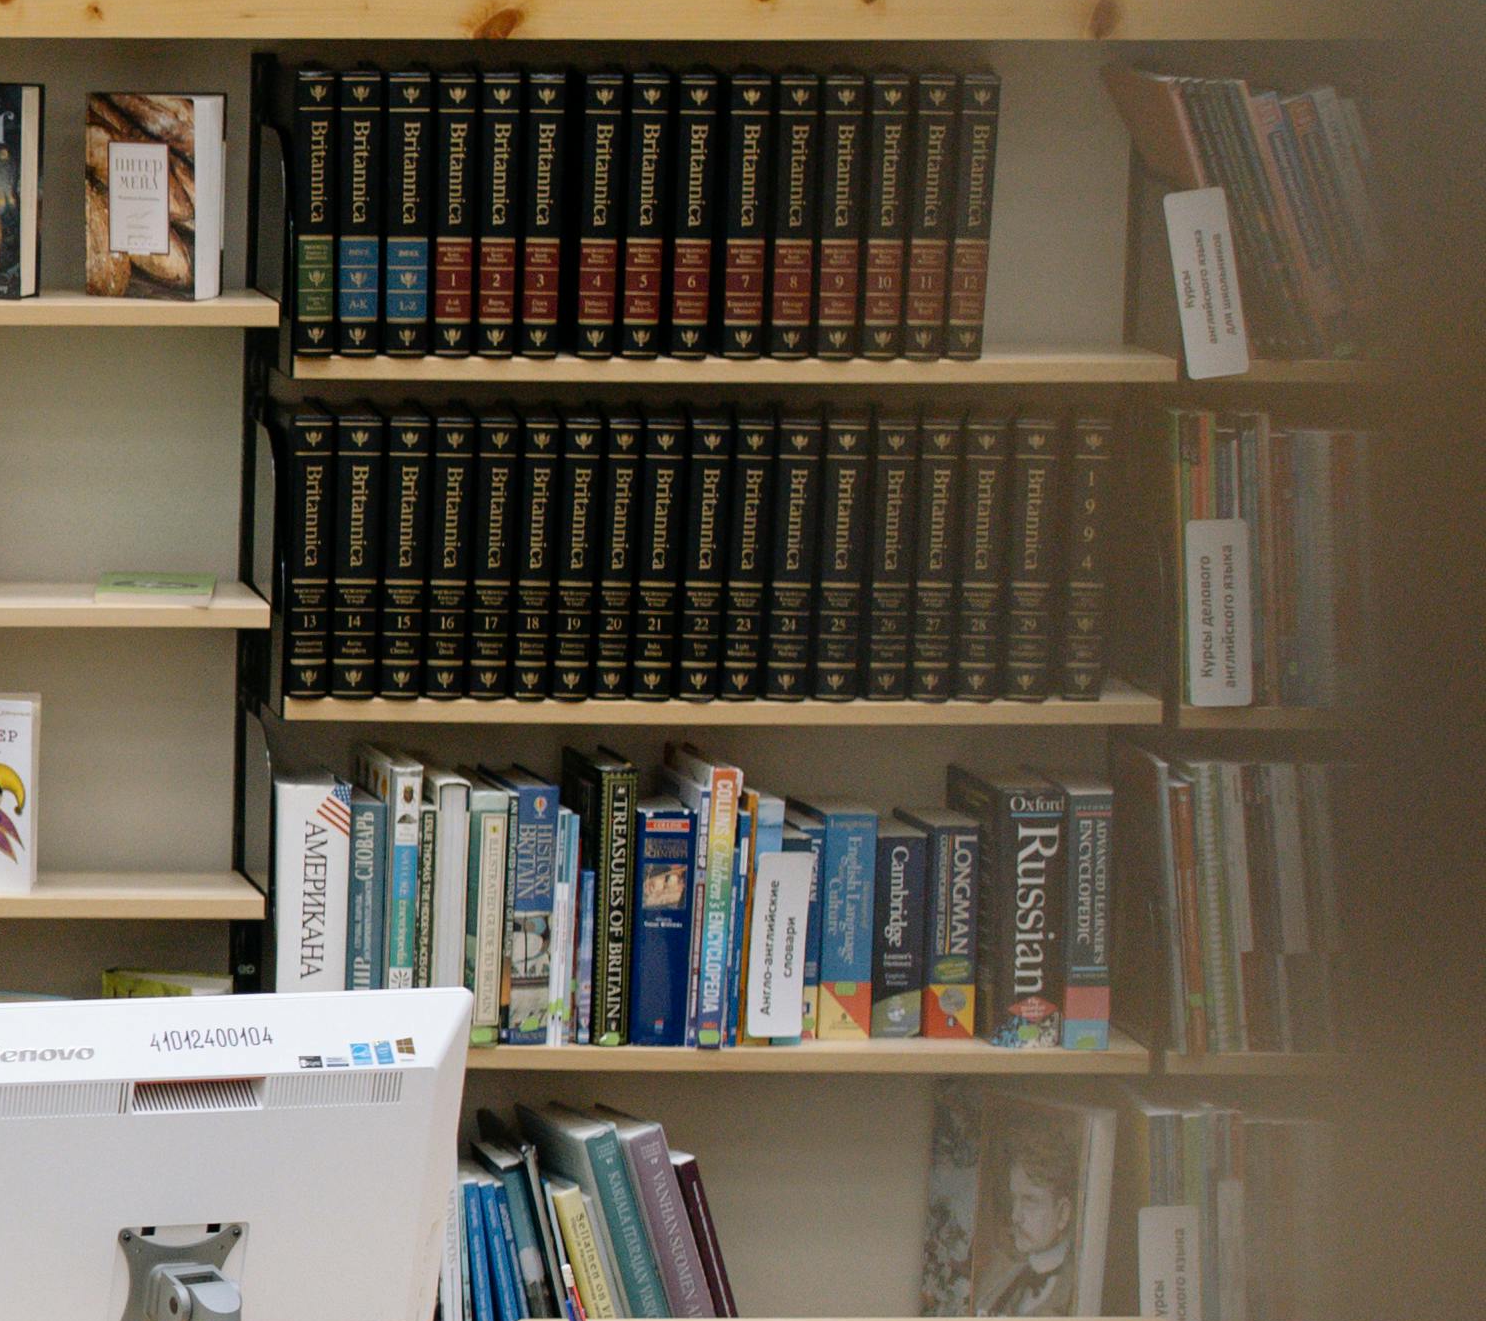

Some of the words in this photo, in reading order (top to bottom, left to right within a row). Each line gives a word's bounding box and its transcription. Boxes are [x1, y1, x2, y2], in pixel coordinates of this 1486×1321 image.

[115, 154, 164, 176] ПИТЕР
[311, 121, 328, 224] Britannica
[352, 121, 371, 224] Britannica
[404, 121, 421, 224] Britannica
[449, 122, 468, 226] Britannica
[493, 122, 511, 226] Britannica
[537, 122, 556, 226] Britannica
[593, 124, 614, 228] Britannica
[305, 465, 323, 567] Britannica
[350, 465, 369, 567] Britannica
[400, 466, 419, 568] Britannica
[488, 467, 508, 569] Britannica
[571, 468, 591, 570] Britannica
[1199, 556, 1213, 626] делового
[1222, 545, 1234, 590] языка
[1200, 631, 1215, 677] Курсы
[1222, 595, 1238, 687] английского
[355, 812, 374, 879] СЛОВАРЬ
[610, 799, 628, 905] TREASURES
[715, 779, 732, 827] COLLINS
[1010, 796, 1064, 812] Oxford
[300, 821, 327, 979] АМЕРИКАНА
[486, 838, 499, 911] ILLUSTRATED
[518, 824, 536, 899] BRITAIN
[536, 824, 553, 898] HISTORY
[847, 836, 862, 893] English
[884, 846, 909, 947] Cambridge
[951, 833, 978, 955] LONGMAN
[1014, 823, 1059, 995] Russian
[1076, 820, 1092, 945] ENCYCLOPEDIC
[485, 913, 498, 947] GUIDE
[609, 910, 624, 936] OF
[702, 911, 724, 1014] ENCYCLOPEDIA
[760, 881, 780, 1016] Англо-английские
[782, 917, 796, 978] словари
[842, 899, 860, 965] Language
[481, 971, 495, 1015] BRITAIN
[607, 942, 622, 1019] BRITAIN
[150, 1027, 273, 1052] 41012400104
[653, 1172, 682, 1235] VANHAN
[672, 1234, 699, 1311] SUOMEN
